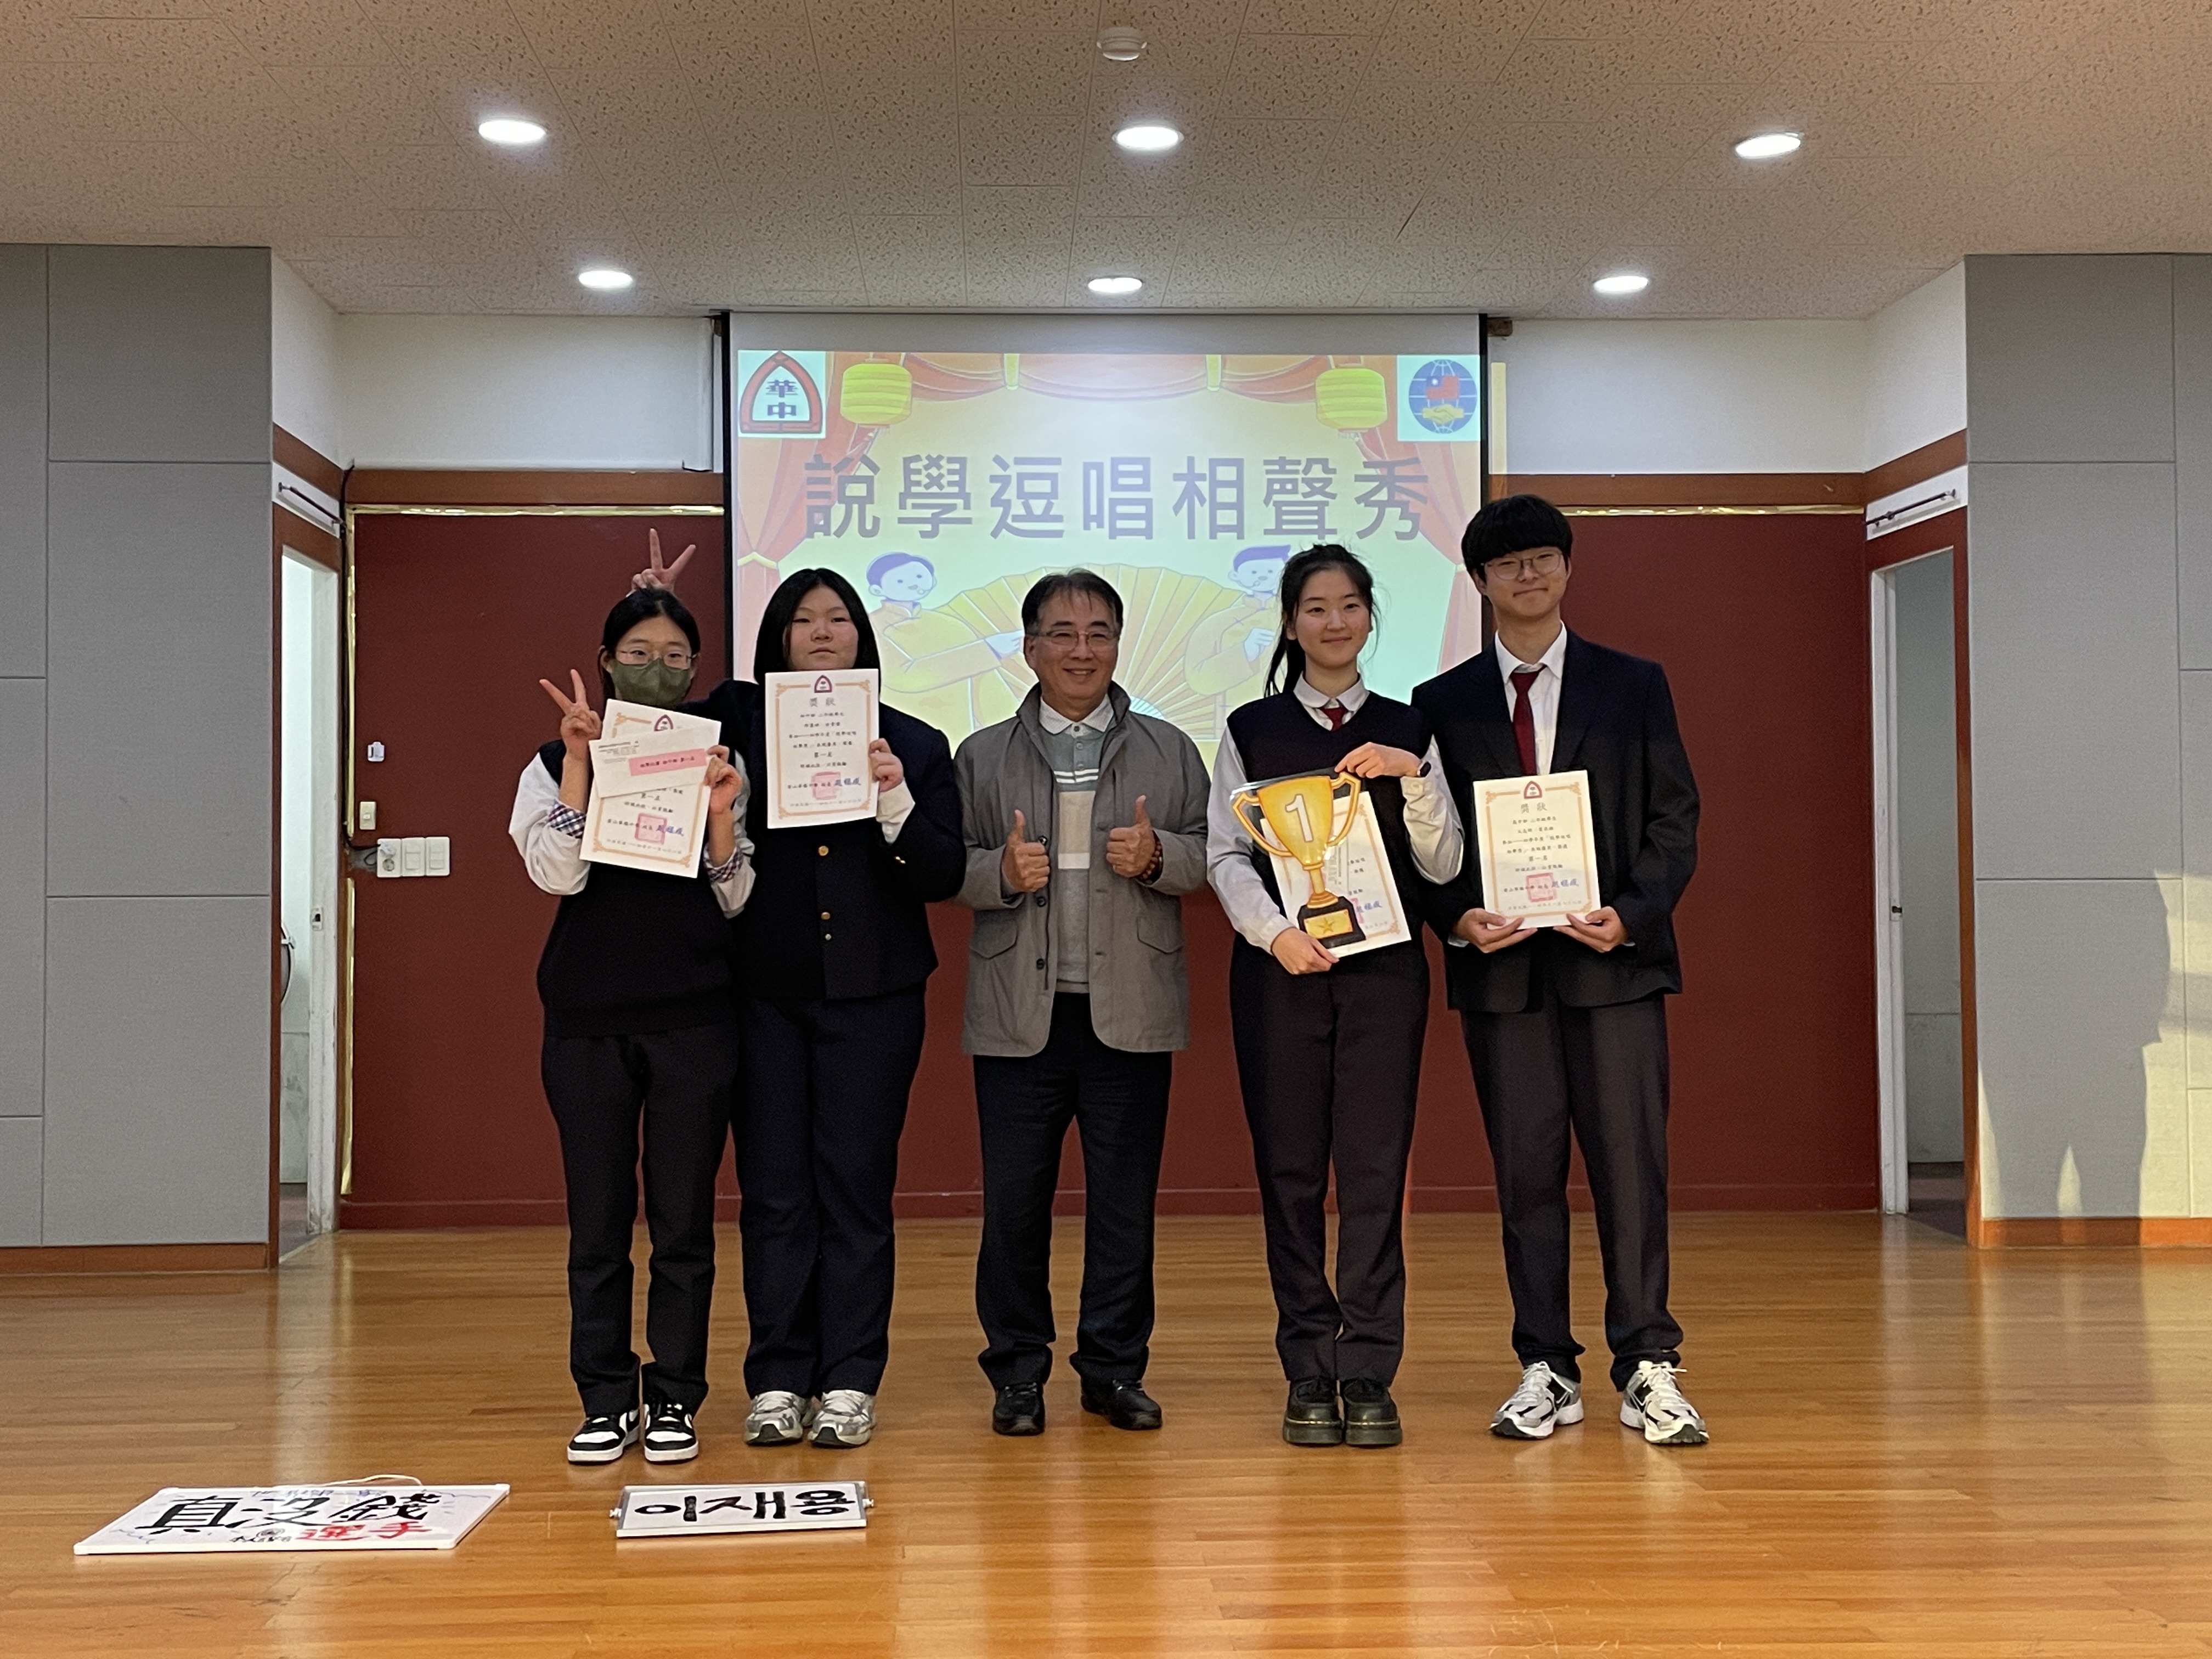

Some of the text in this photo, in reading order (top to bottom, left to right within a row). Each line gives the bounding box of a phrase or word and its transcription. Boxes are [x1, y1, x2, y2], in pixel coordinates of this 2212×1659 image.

[766, 380, 798, 419] 華中
[804, 453, 1429, 540] 說學逗唱相聲秀
[1285, 794, 1314, 842] 1
[634, 1490, 855, 1522] 이재용
[296, 1521, 432, 1541] 選手
